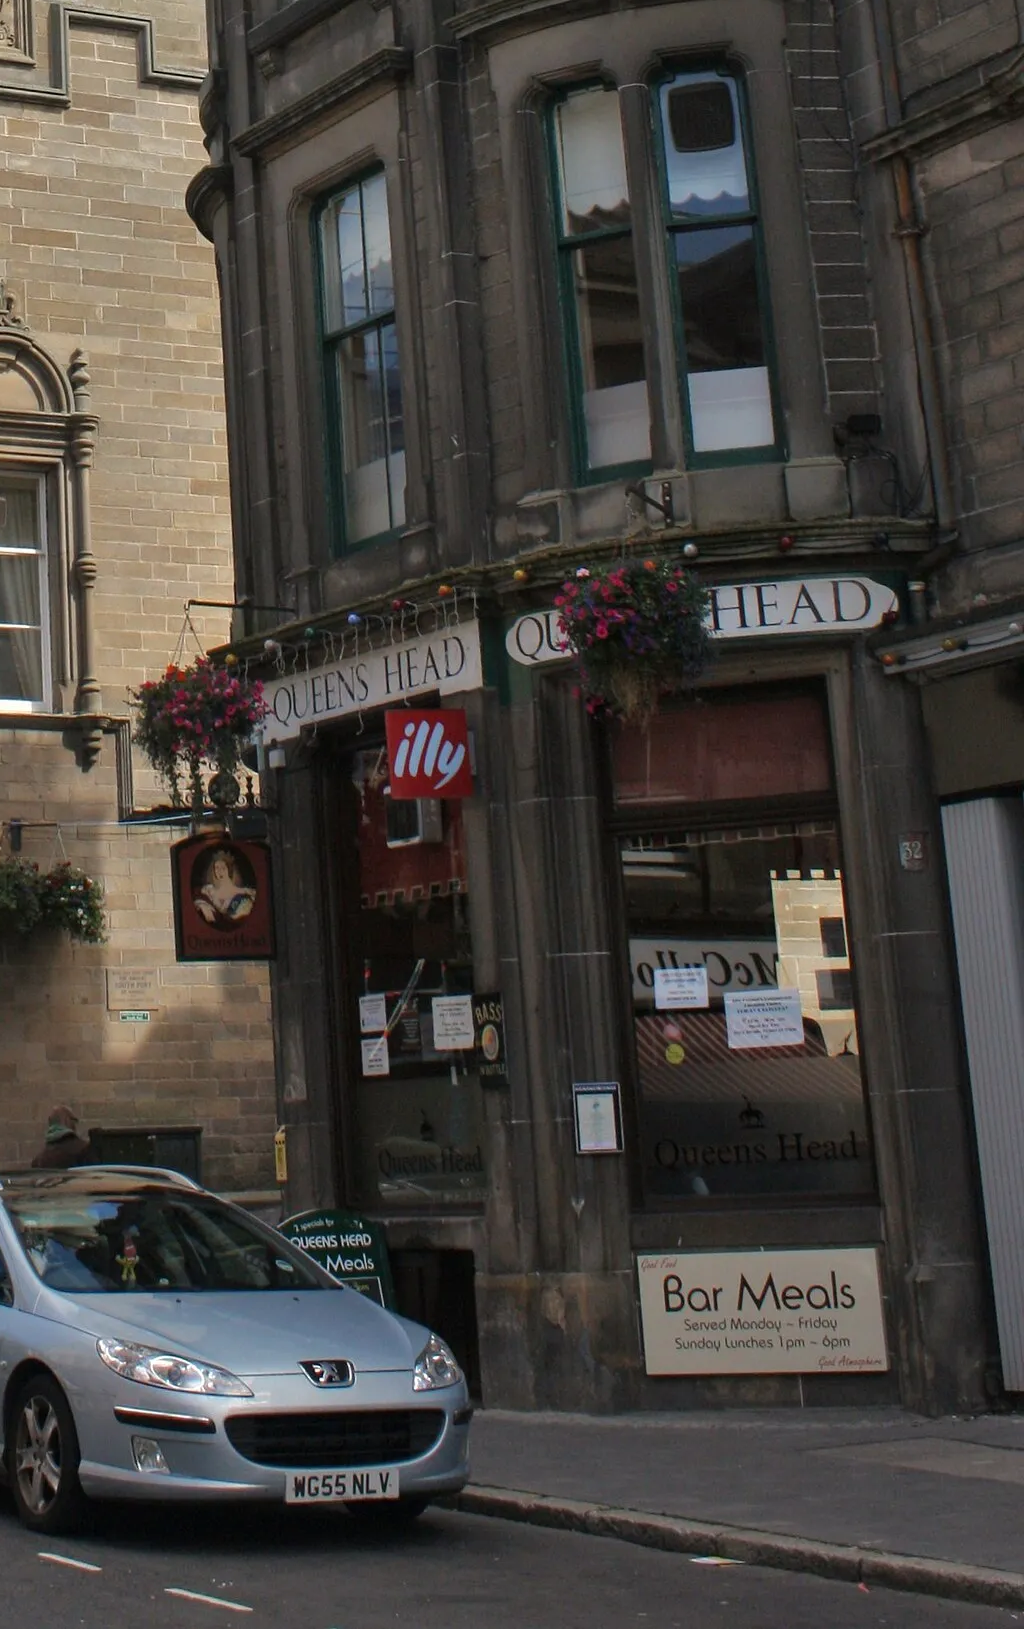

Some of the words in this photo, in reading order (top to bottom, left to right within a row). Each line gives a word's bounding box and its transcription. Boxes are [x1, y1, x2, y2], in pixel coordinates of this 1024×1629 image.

[709, 579, 871, 630] HEAD
[273, 663, 368, 727] QUEENS
[383, 636, 466, 694] HEAD
[394, 720, 465, 790] illy
[902, 841, 922, 859] 32
[475, 1001, 503, 1025] BASS
[654, 1138, 767, 1169] Queens
[777, 1130, 860, 1162] Head
[291, 1235, 338, 1249] QUEENS
[340, 1233, 372, 1248] HEAD
[326, 1253, 375, 1272] Meals
[663, 1274, 723, 1313] Bar
[737, 1271, 856, 1311] Meals
[684, 1318, 726, 1331] Served
[730, 1317, 782, 1332] Monday
[799, 1316, 837, 1331] Friday
[675, 1337, 721, 1352] Sunday
[725, 1336, 774, 1350] Lunches
[778, 1336, 805, 1351] 1pm
[822, 1335, 851, 1350] 6pm
[294, 1474, 346, 1498] WG55
[352, 1472, 390, 1495] NLV
